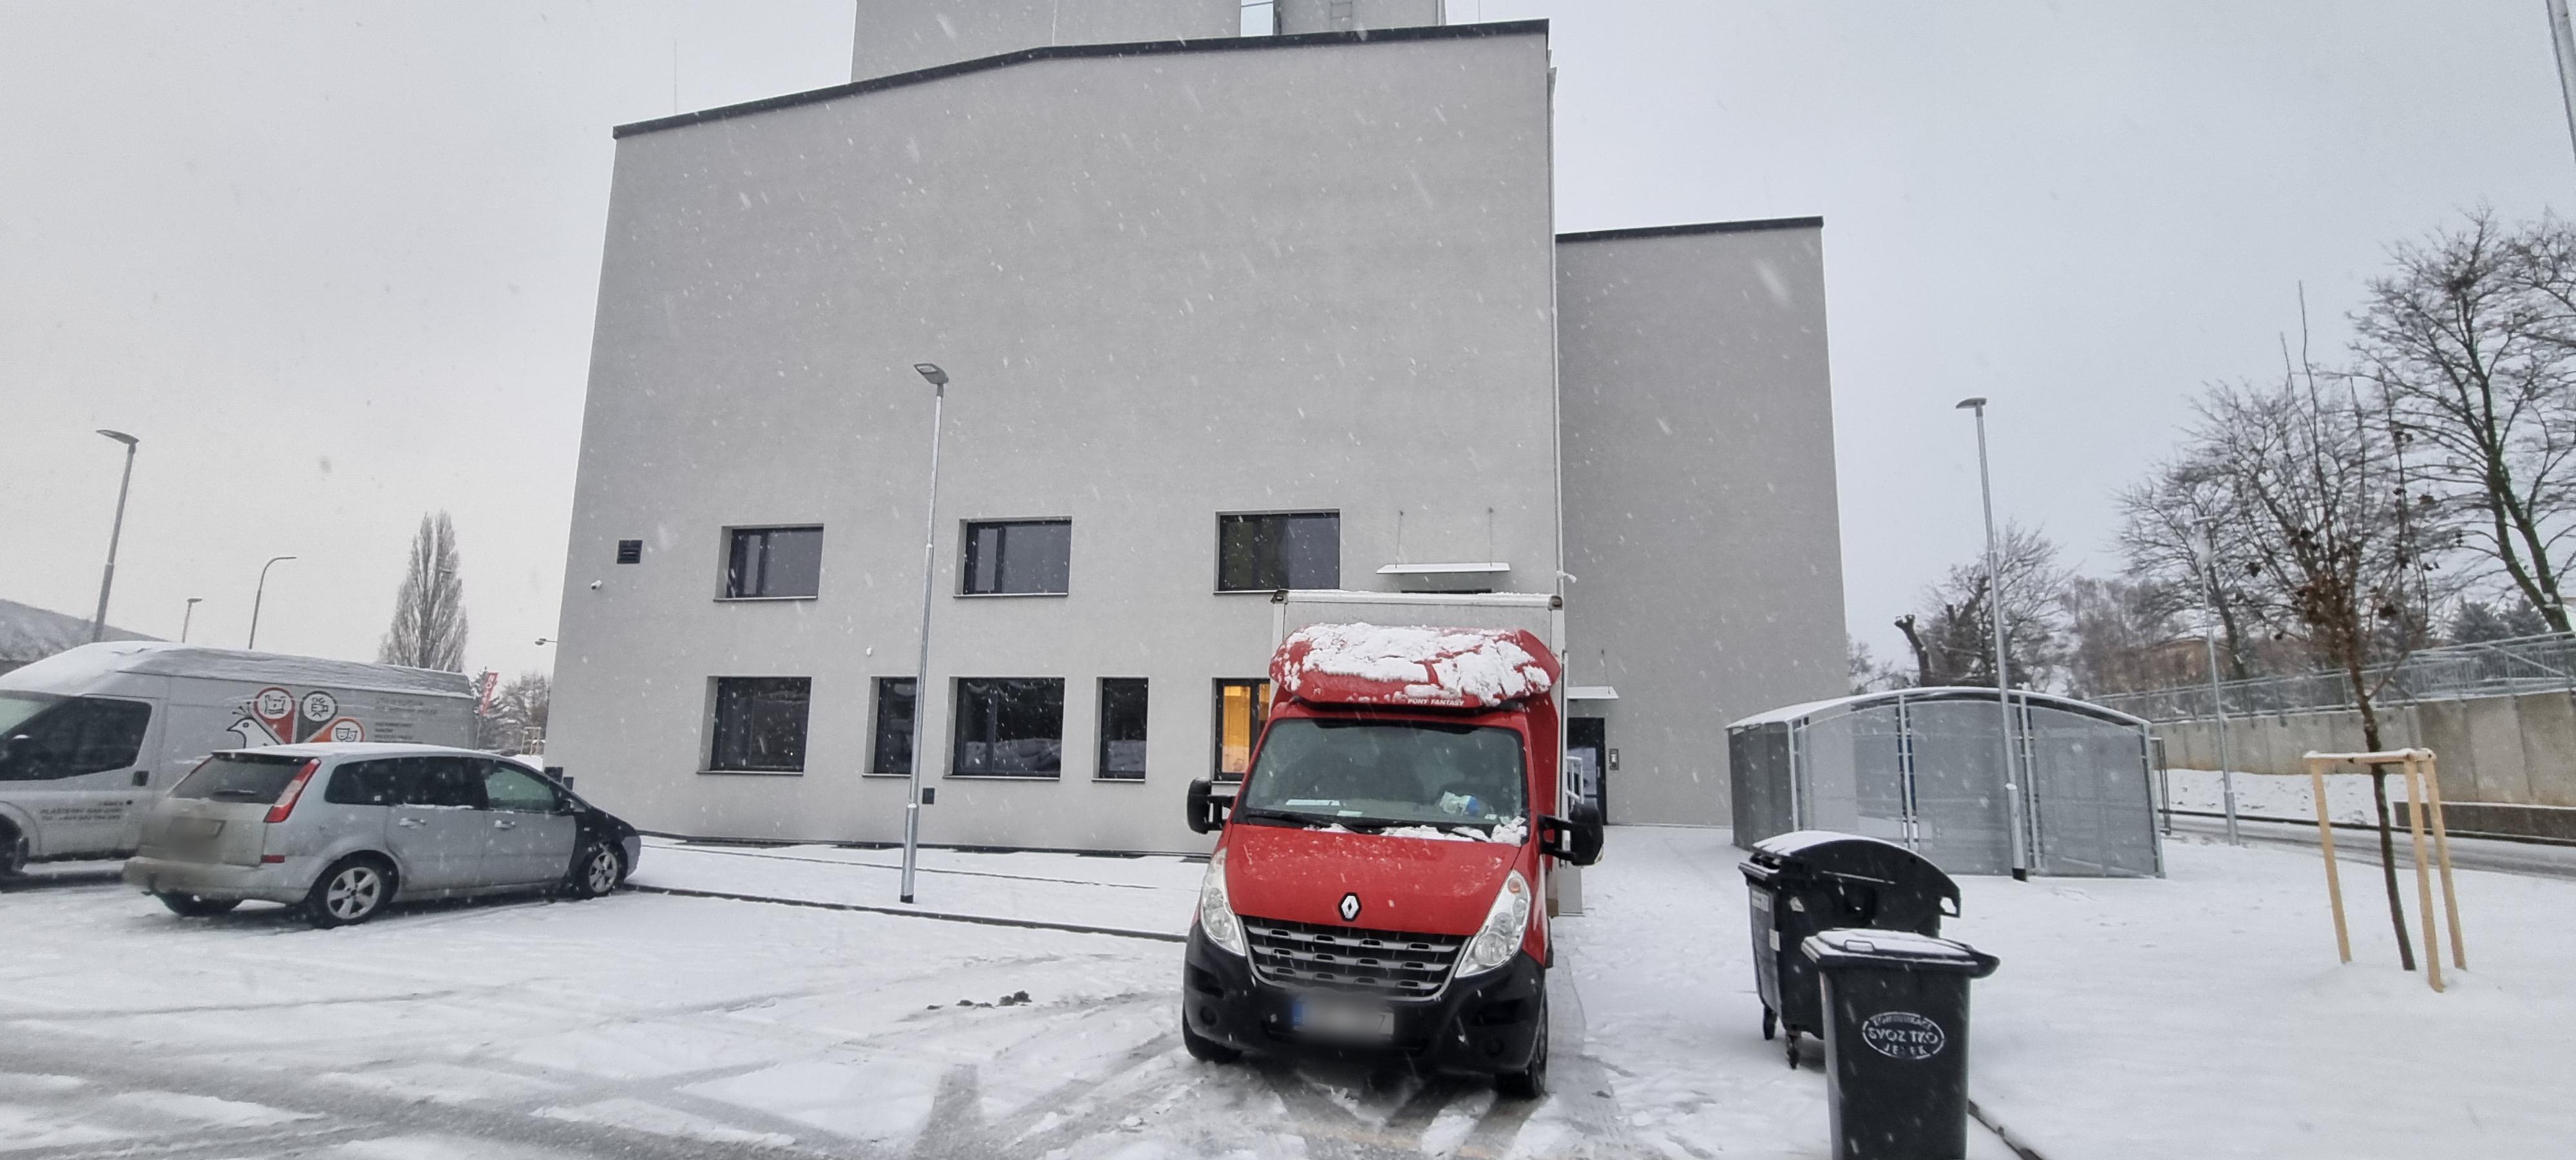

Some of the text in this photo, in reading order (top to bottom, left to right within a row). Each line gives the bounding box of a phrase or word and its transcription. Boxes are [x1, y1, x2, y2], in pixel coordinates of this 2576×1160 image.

[1868, 1027, 1939, 1044] SVOZ TKO
[1884, 1043, 1927, 1056] JEEK
